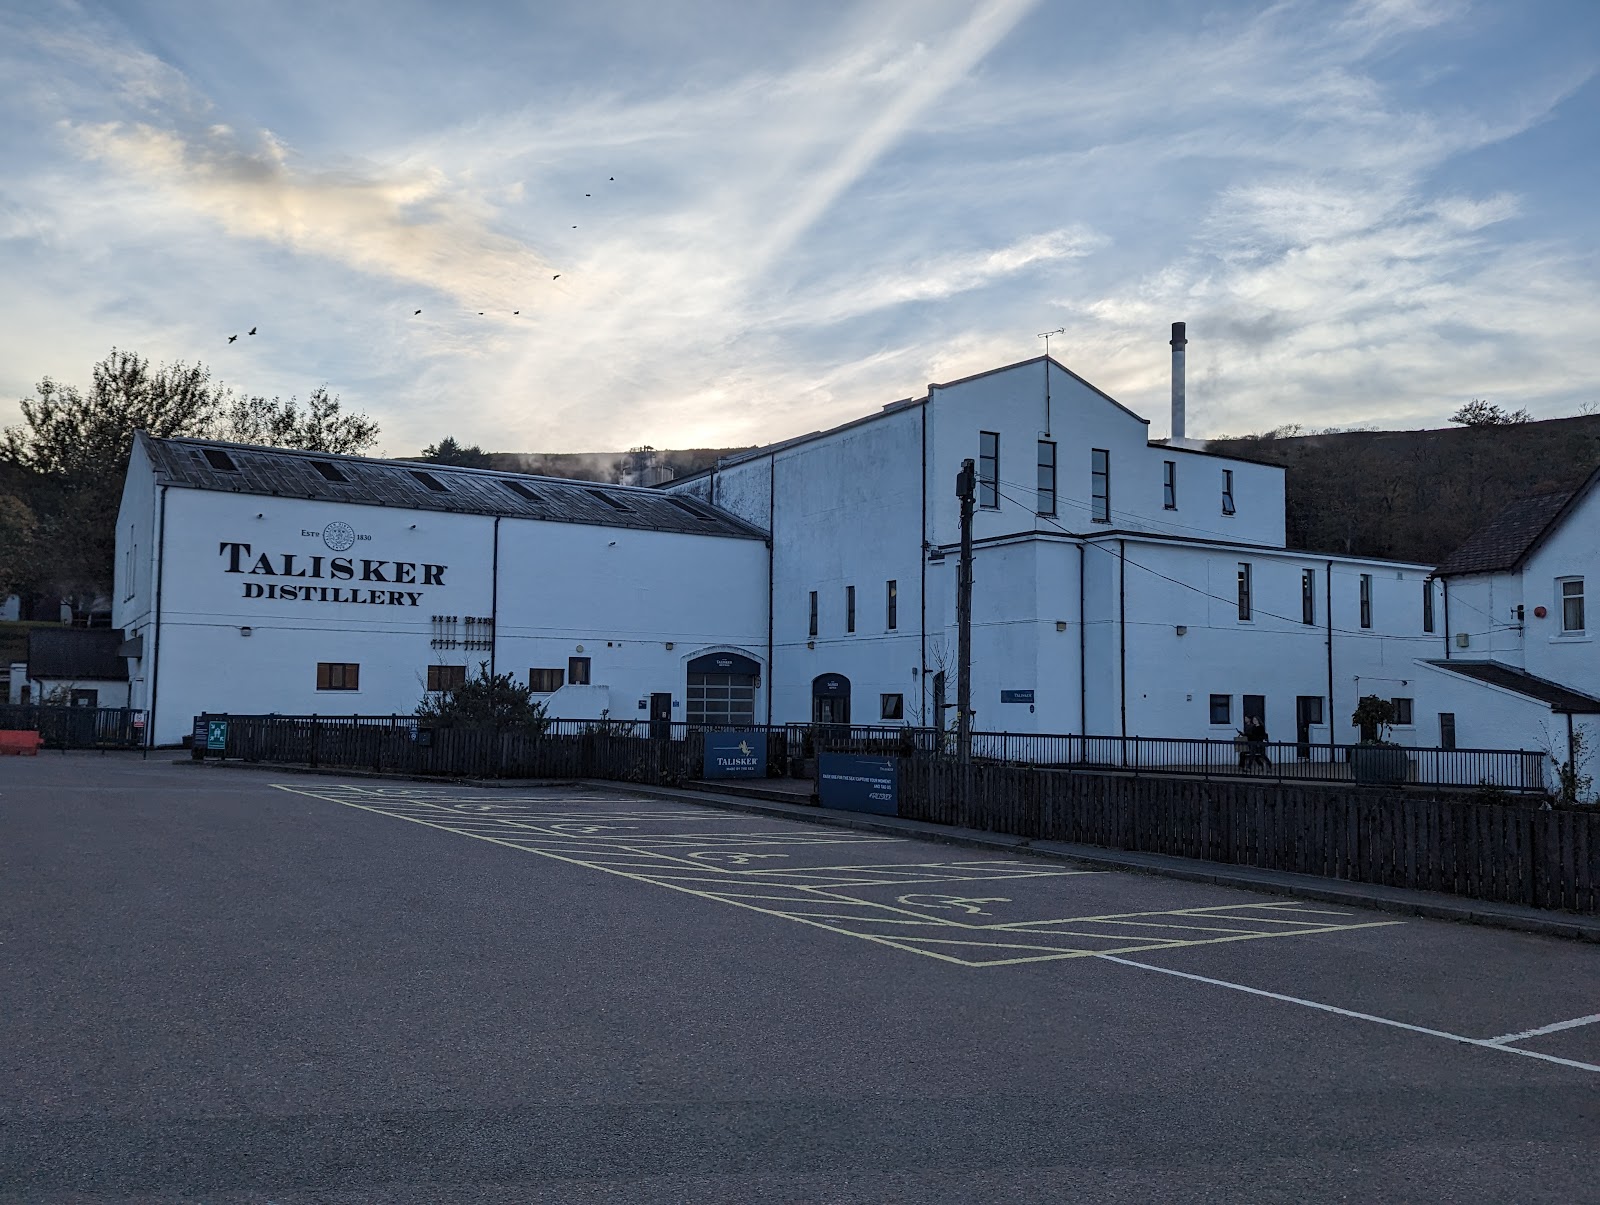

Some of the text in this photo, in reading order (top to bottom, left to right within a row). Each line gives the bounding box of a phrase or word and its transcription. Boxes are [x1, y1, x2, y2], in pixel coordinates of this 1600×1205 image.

[219, 542, 447, 586] TALISKER
[242, 582, 424, 607] DISTILLERY
[717, 757, 757, 766] TALISKER
